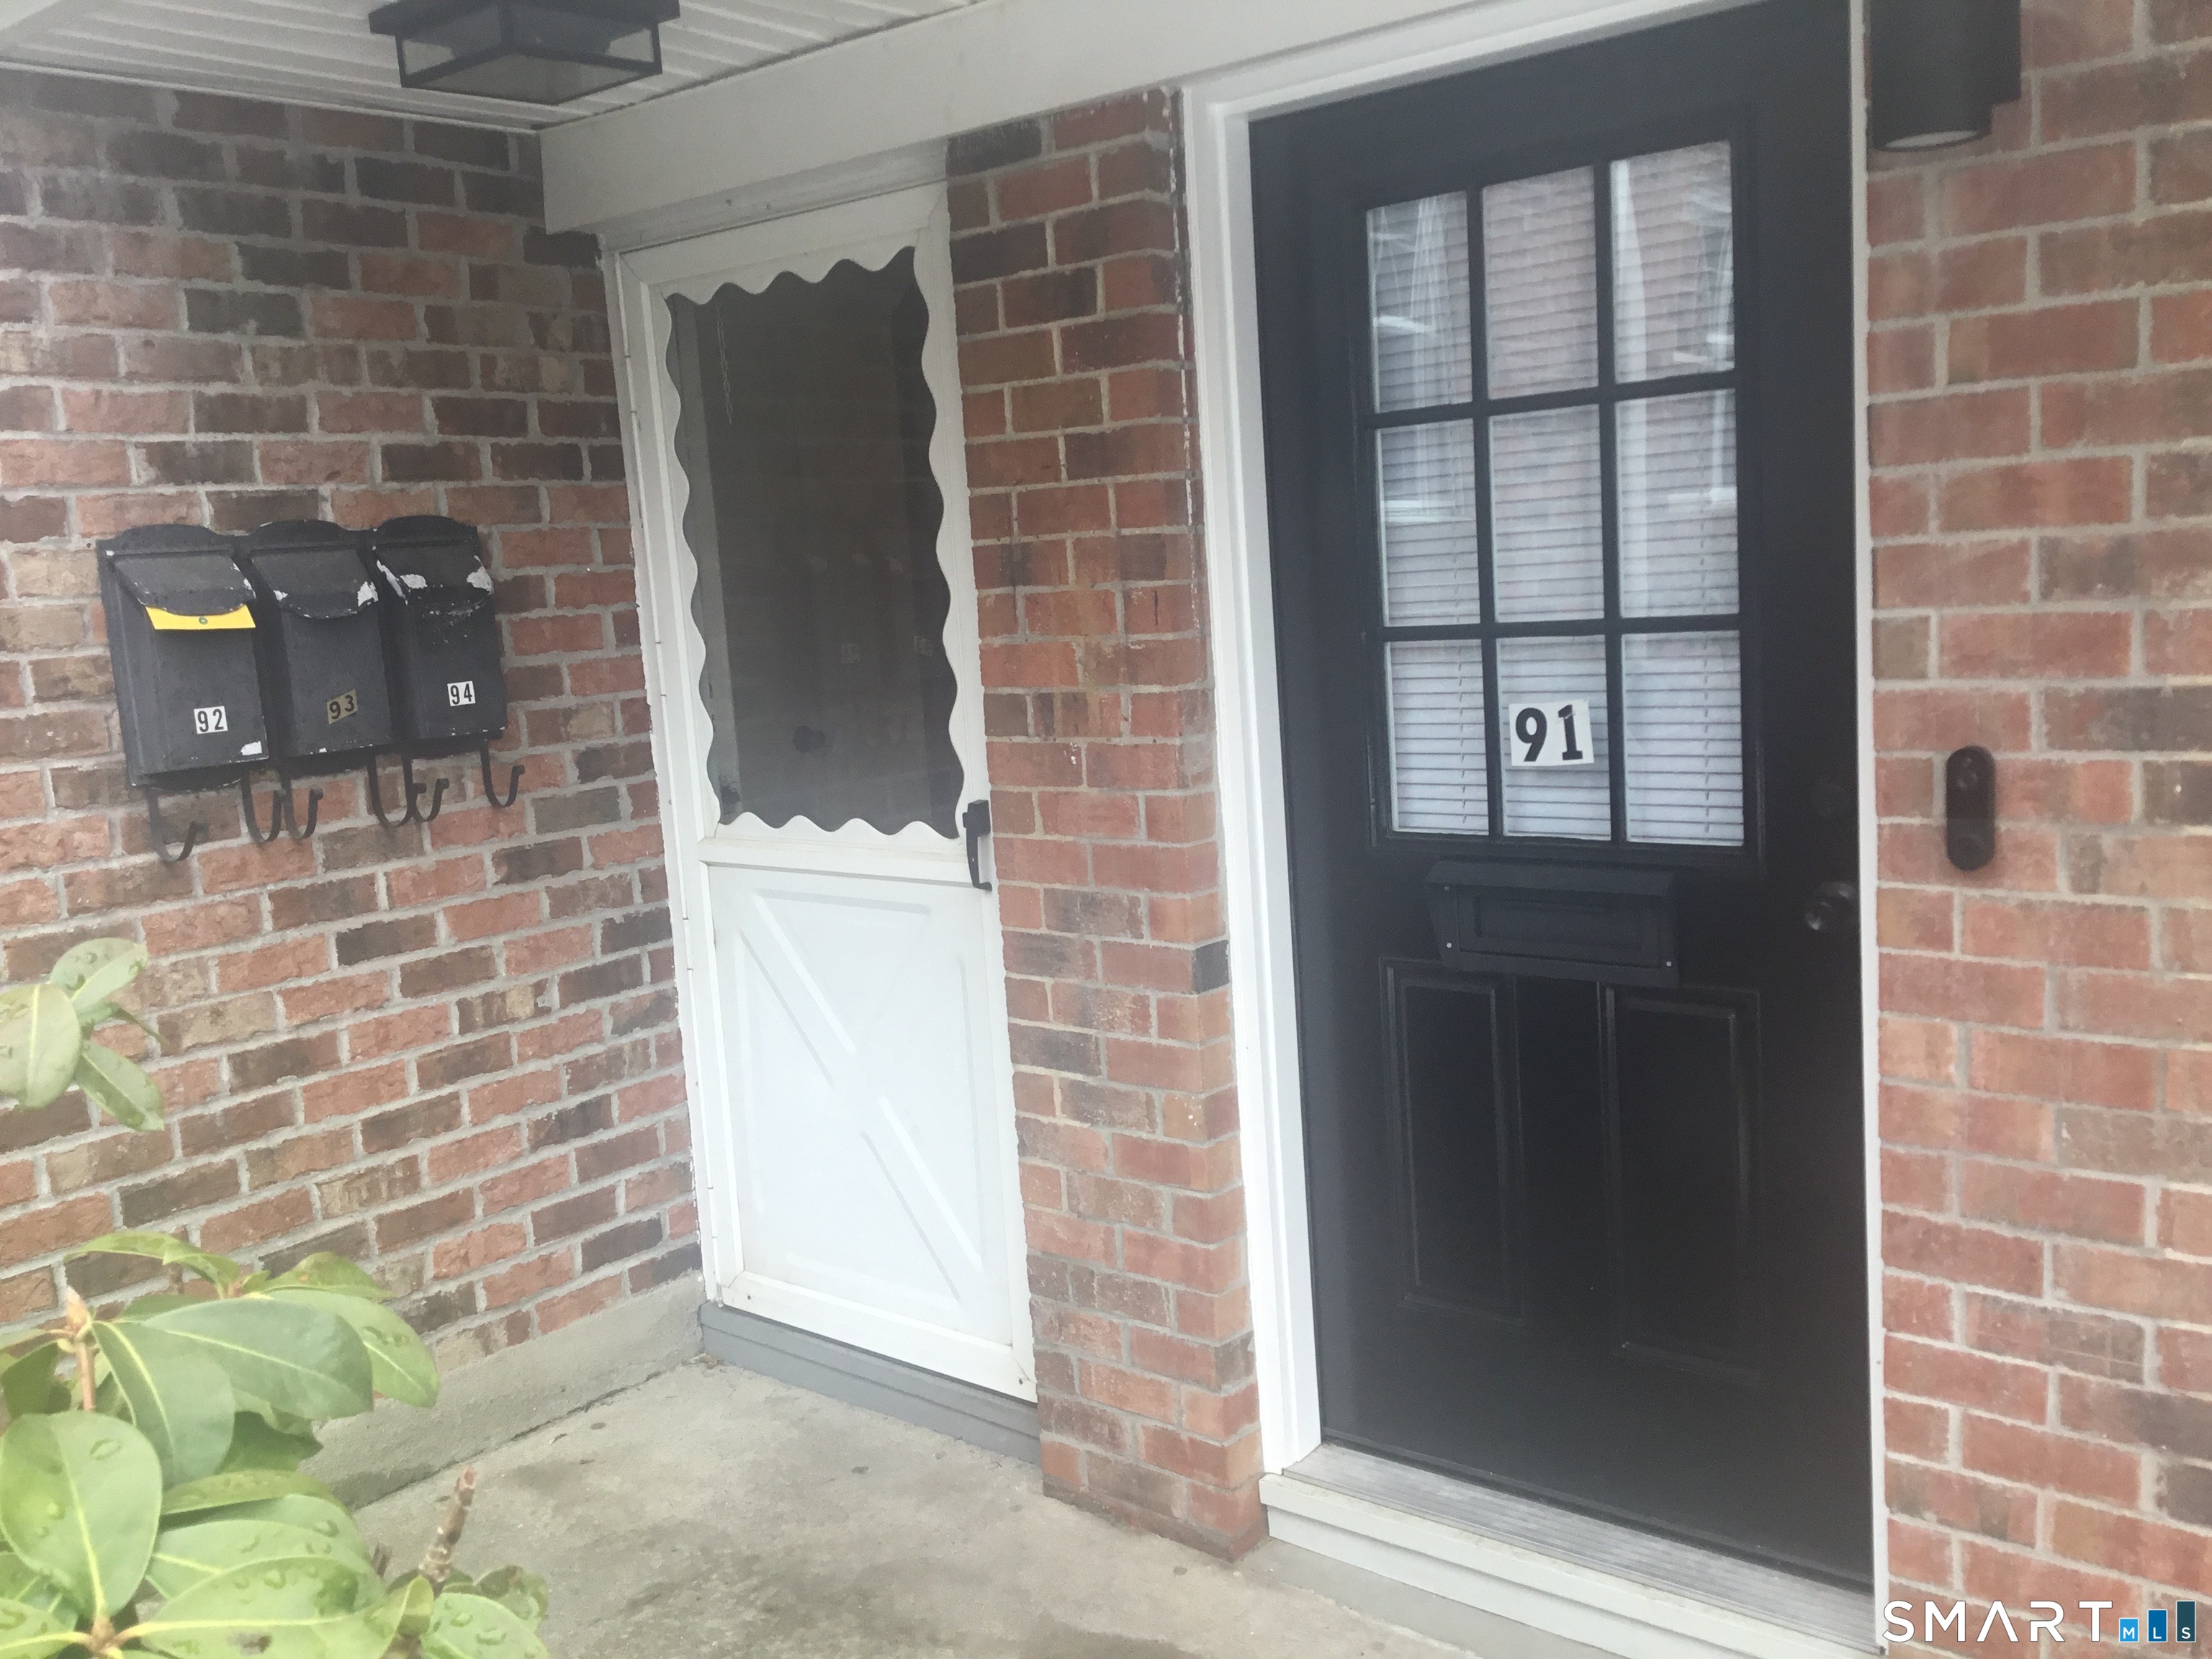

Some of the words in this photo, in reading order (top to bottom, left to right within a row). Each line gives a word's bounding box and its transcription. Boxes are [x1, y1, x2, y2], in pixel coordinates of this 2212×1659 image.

[450, 683, 473, 705] 94
[329, 694, 355, 720] 93
[197, 709, 224, 732] 92
[1515, 704, 1583, 763] 91
